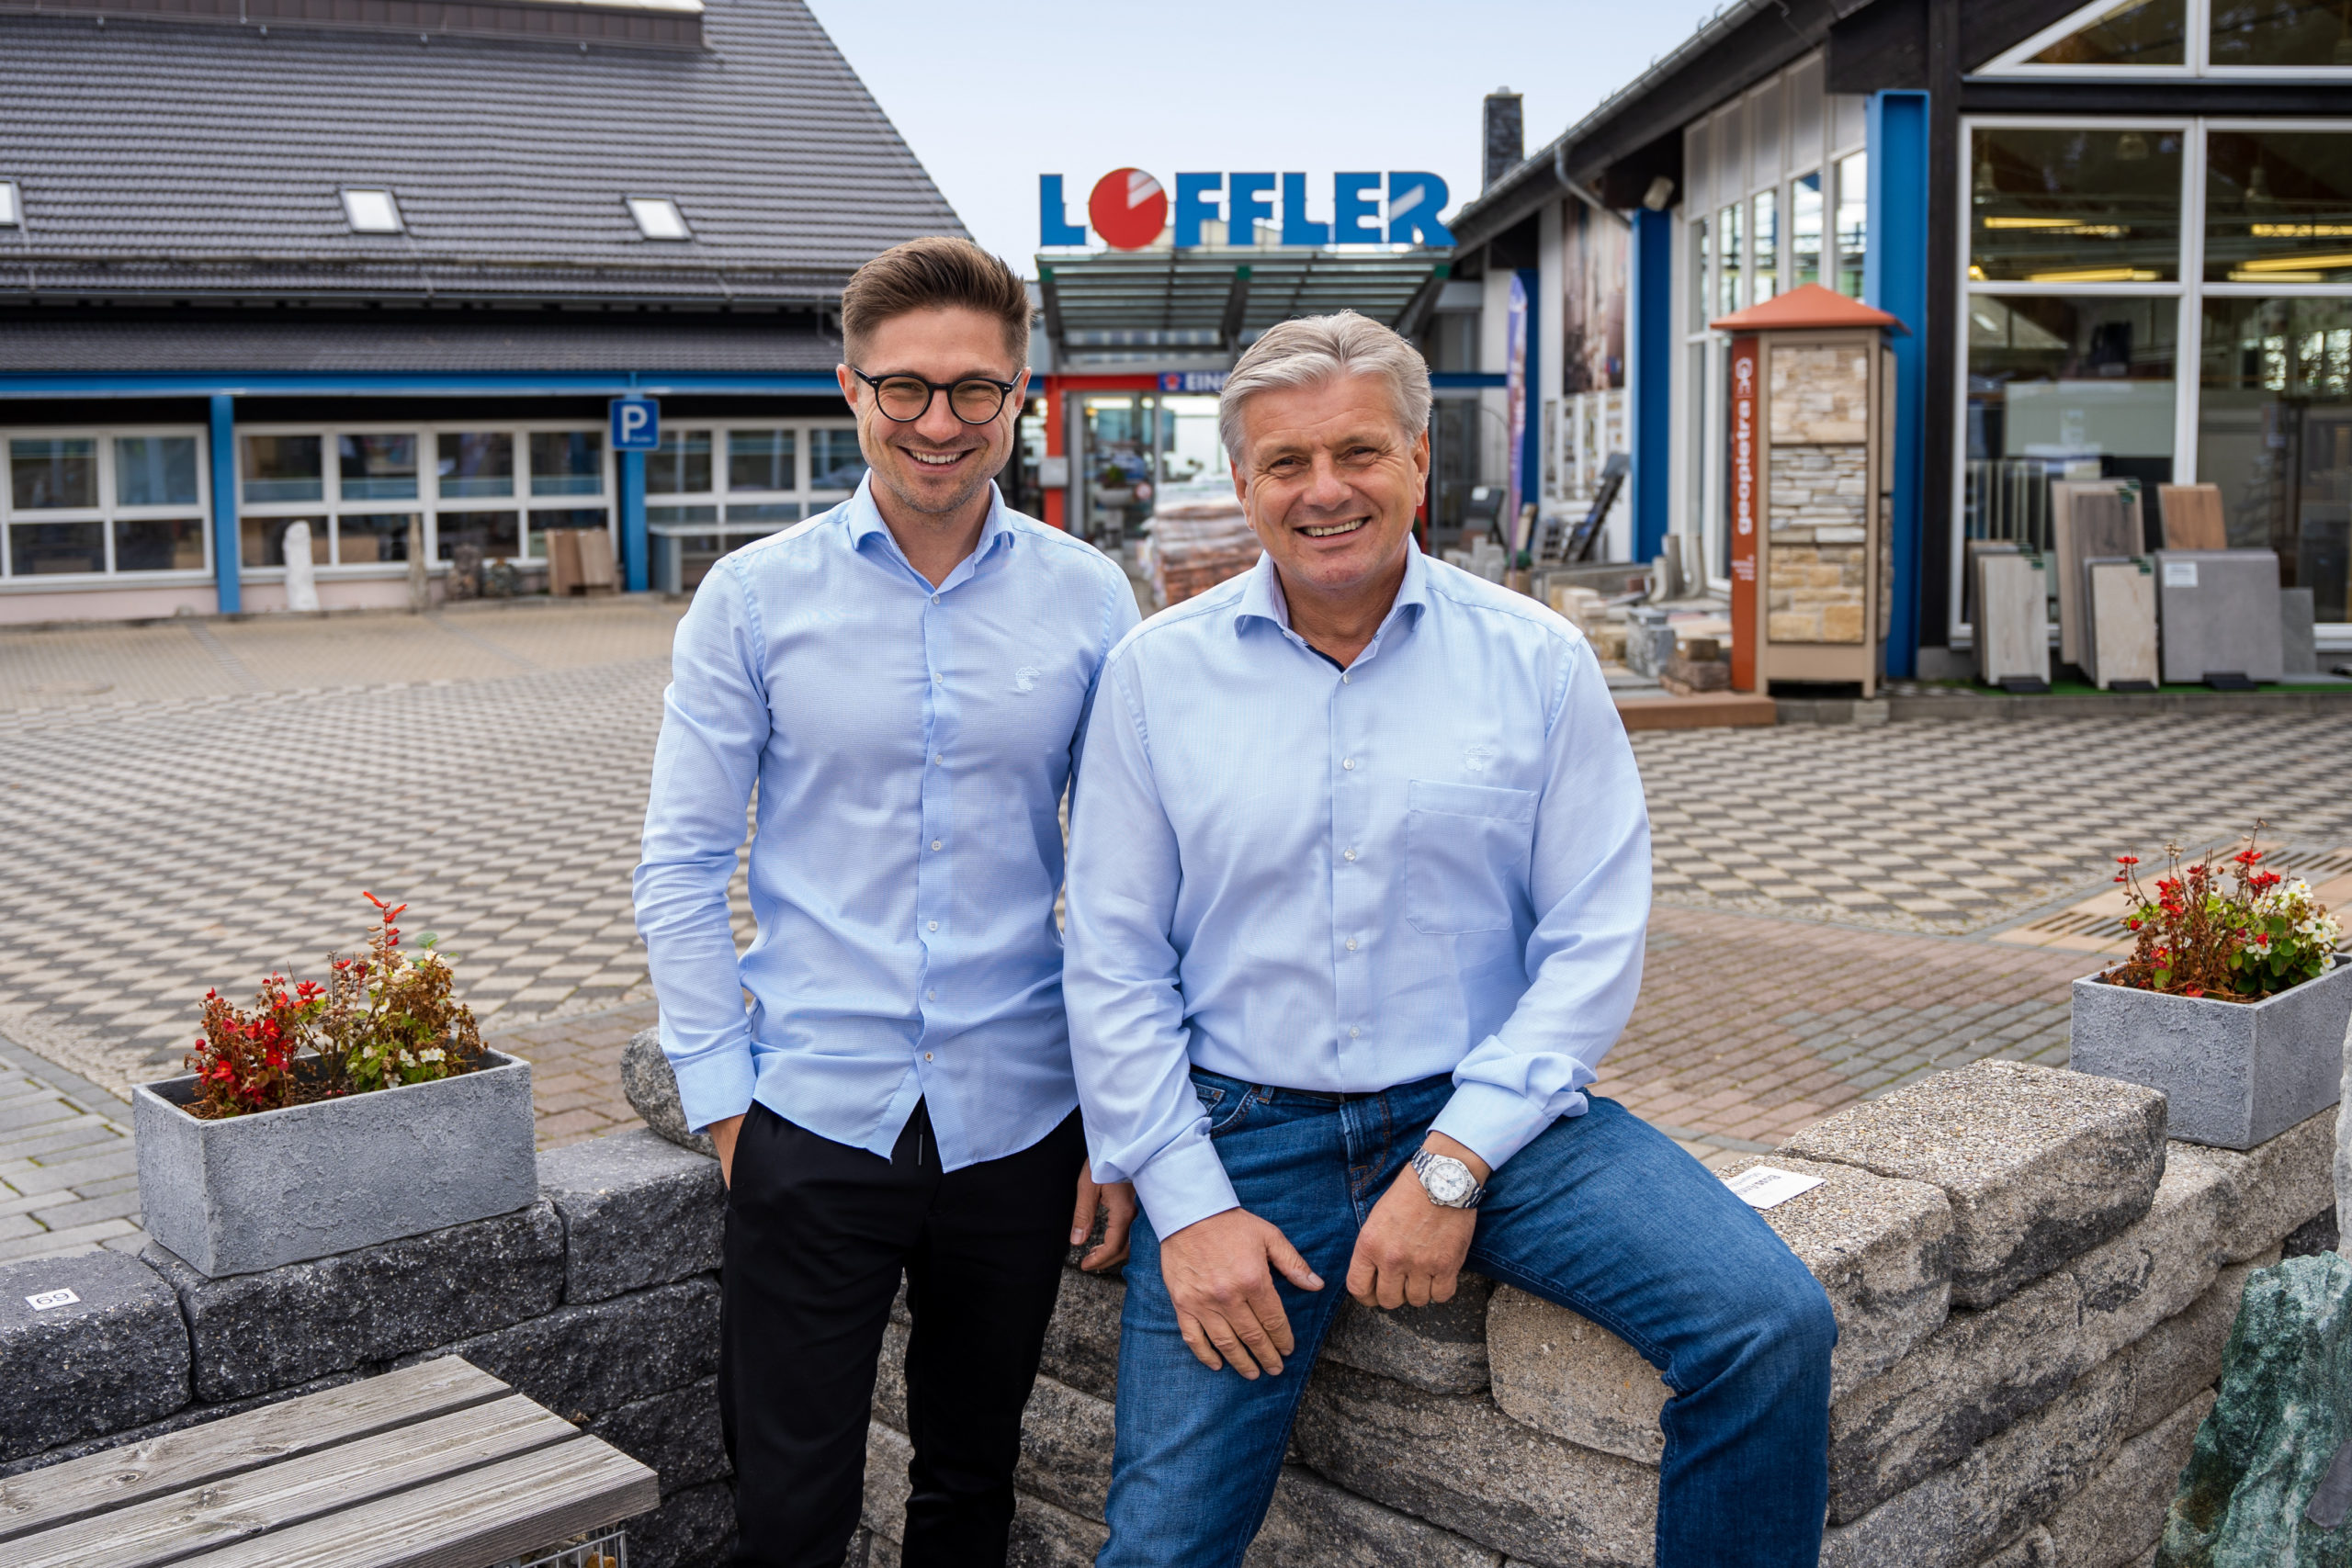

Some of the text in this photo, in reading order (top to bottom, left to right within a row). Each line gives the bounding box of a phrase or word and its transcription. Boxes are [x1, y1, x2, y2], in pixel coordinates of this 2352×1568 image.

[621, 404, 648, 443] P
[1736, 400, 1753, 536] geopietra
[37, 1292, 69, 1305] 69
